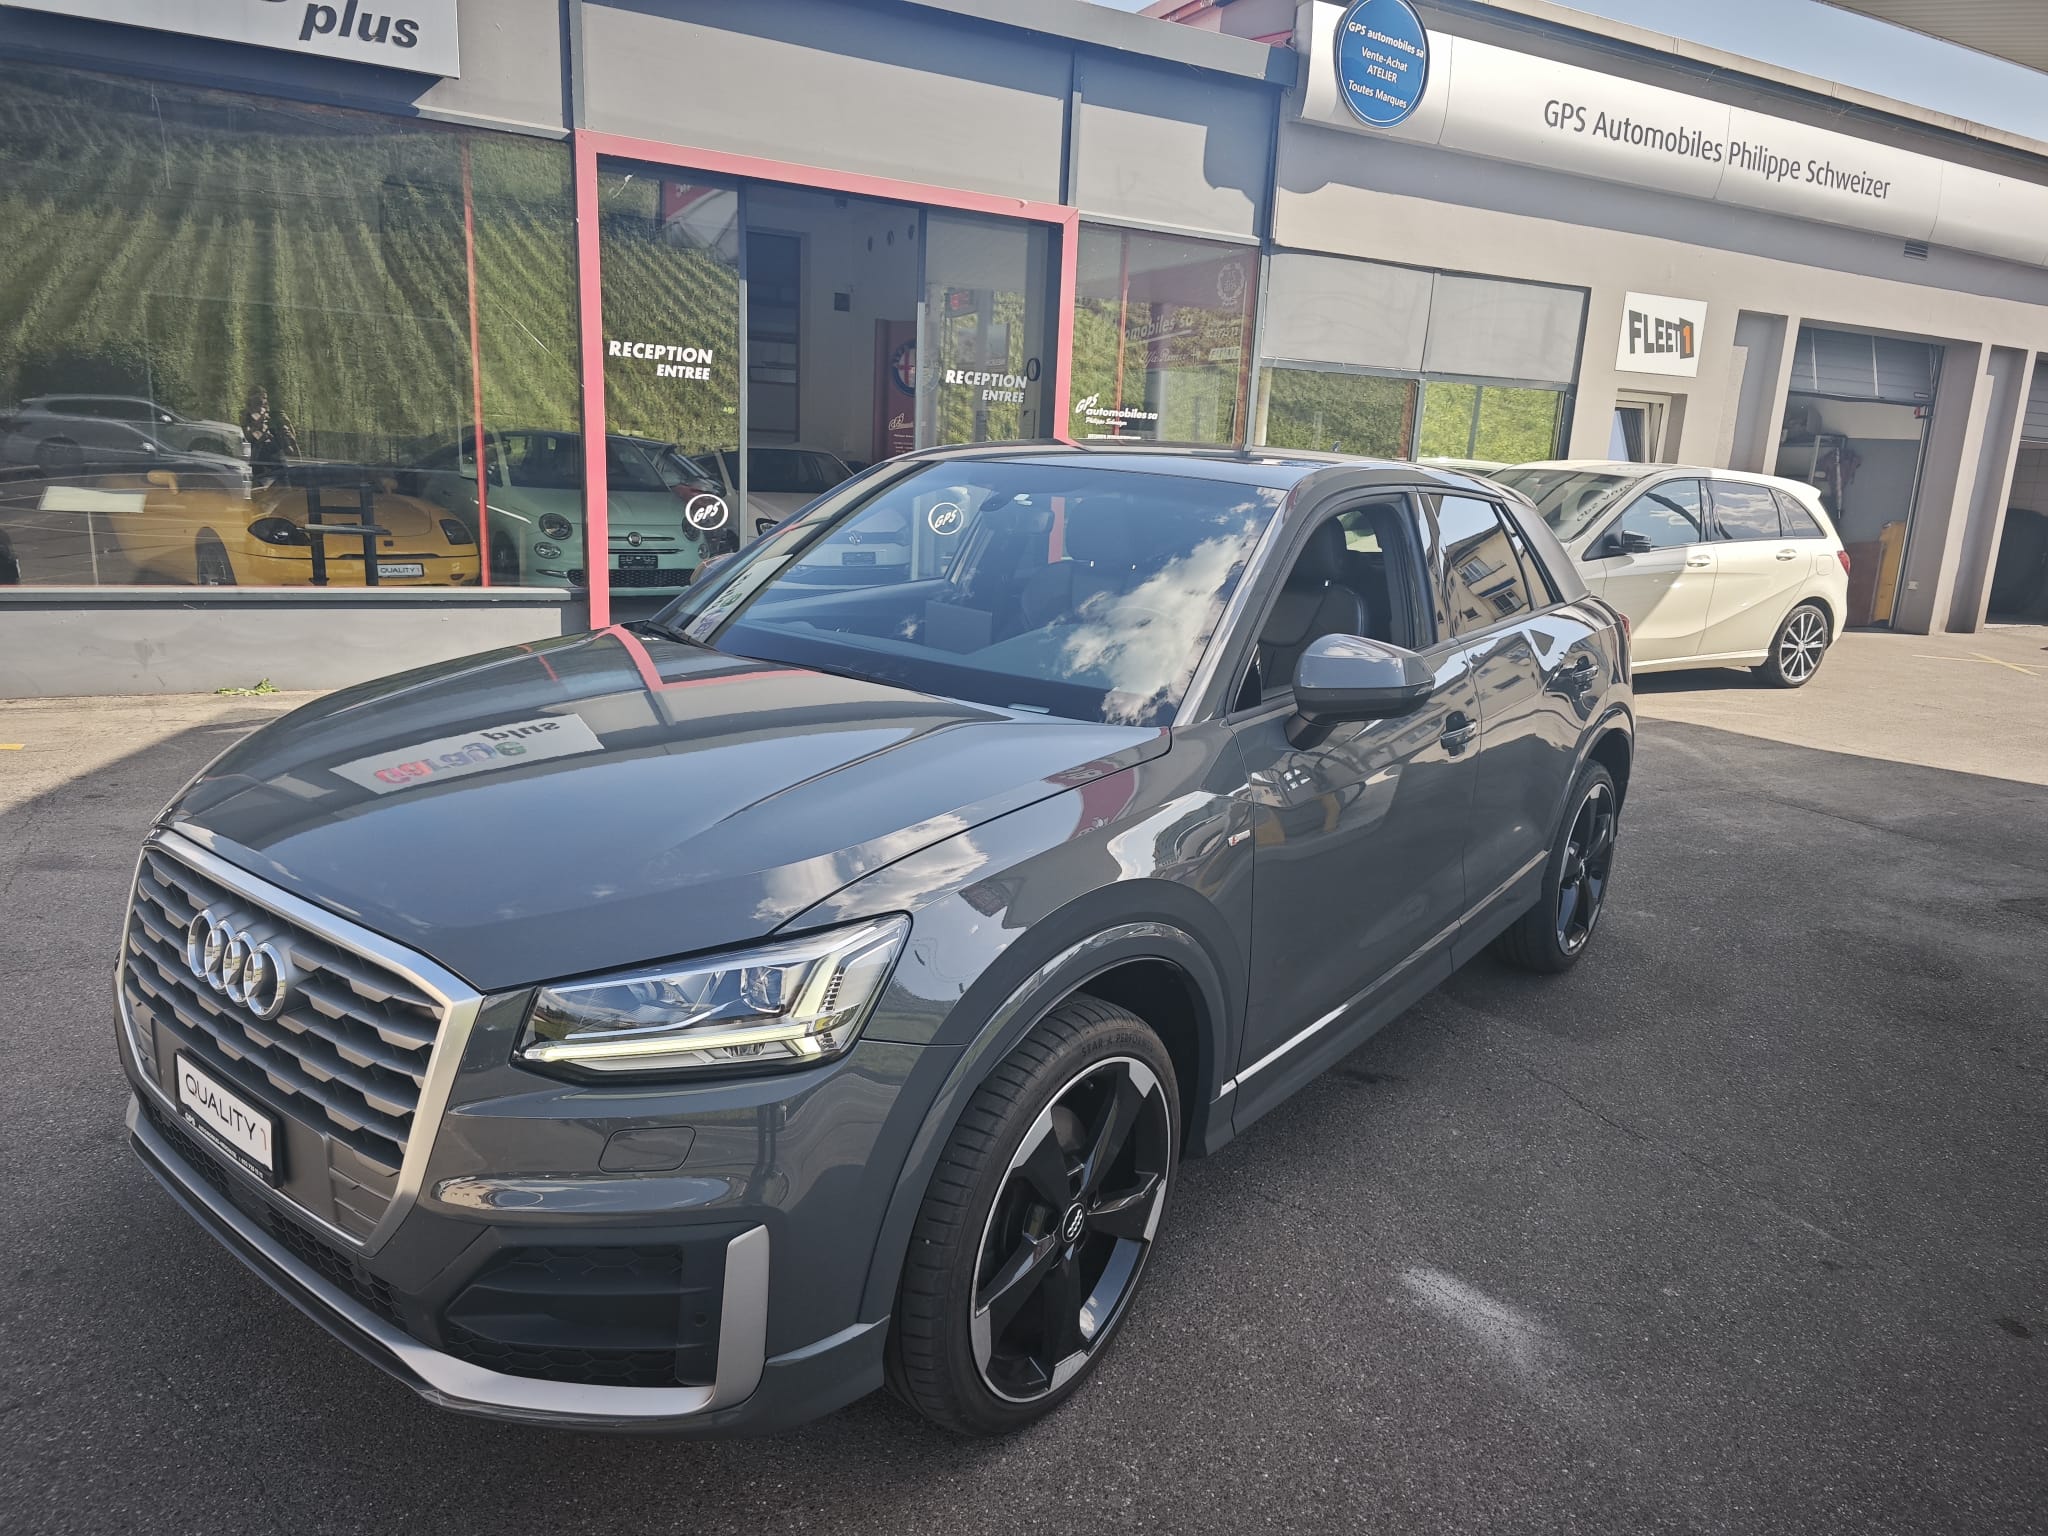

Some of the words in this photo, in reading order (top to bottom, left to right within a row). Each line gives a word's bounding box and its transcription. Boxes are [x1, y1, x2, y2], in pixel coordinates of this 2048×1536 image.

[299, 0, 420, 48] plus
[1348, 22, 1367, 36] GPS
[1367, 29, 1416, 55] automobiles
[1416, 47, 1425, 58] sa
[1362, 46, 1408, 72] Vente-Achat
[1366, 64, 1398, 84] ATELIER
[1348, 79, 1374, 97] Toutes
[1375, 88, 1407, 109] Marques
[1544, 99, 1587, 133] GPS
[1593, 111, 1723, 163] Automobiles
[1728, 141, 1801, 183] Philippe
[1805, 159, 1891, 200] Schweizer
[608, 340, 713, 365] RECEPTION
[656, 364, 711, 381] ENTREE
[945, 369, 1028, 389] RECEPTION
[982, 389, 1026, 404] ENTREE
[1075, 392, 1100, 414] GPS
[1085, 407, 1147, 419] automobiles
[1148, 412, 1159, 421] sa
[693, 501, 721, 523] GPS
[934, 509, 958, 529] GPS
[185, 1073, 256, 1141] QUALITY
